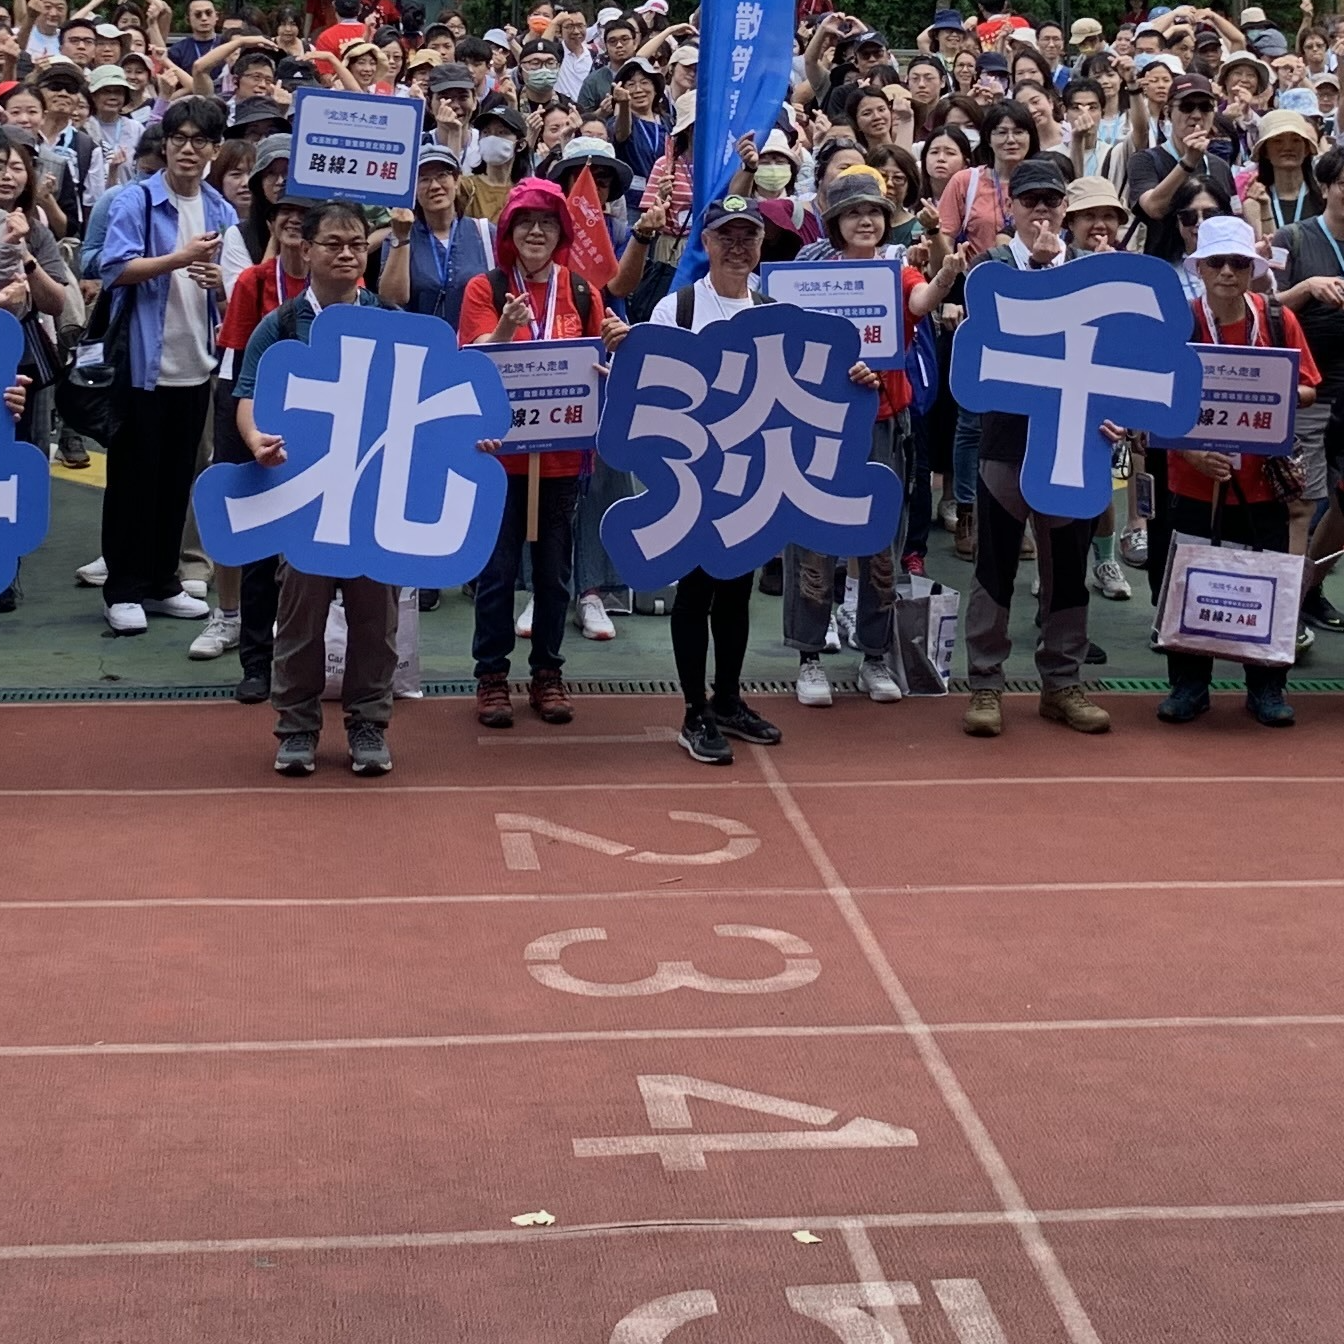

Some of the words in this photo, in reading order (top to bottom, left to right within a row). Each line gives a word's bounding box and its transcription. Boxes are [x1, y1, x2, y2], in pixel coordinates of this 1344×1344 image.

[308, 153, 358, 175] 路線2
[366, 160, 398, 181] D組
[863, 325, 882, 344] 組
[550, 404, 583, 424] C組
[1237, 411, 1272, 429] A組
[494, 810, 761, 871] 2
[524, 924, 822, 997] 3
[572, 1074, 918, 1171] 4
